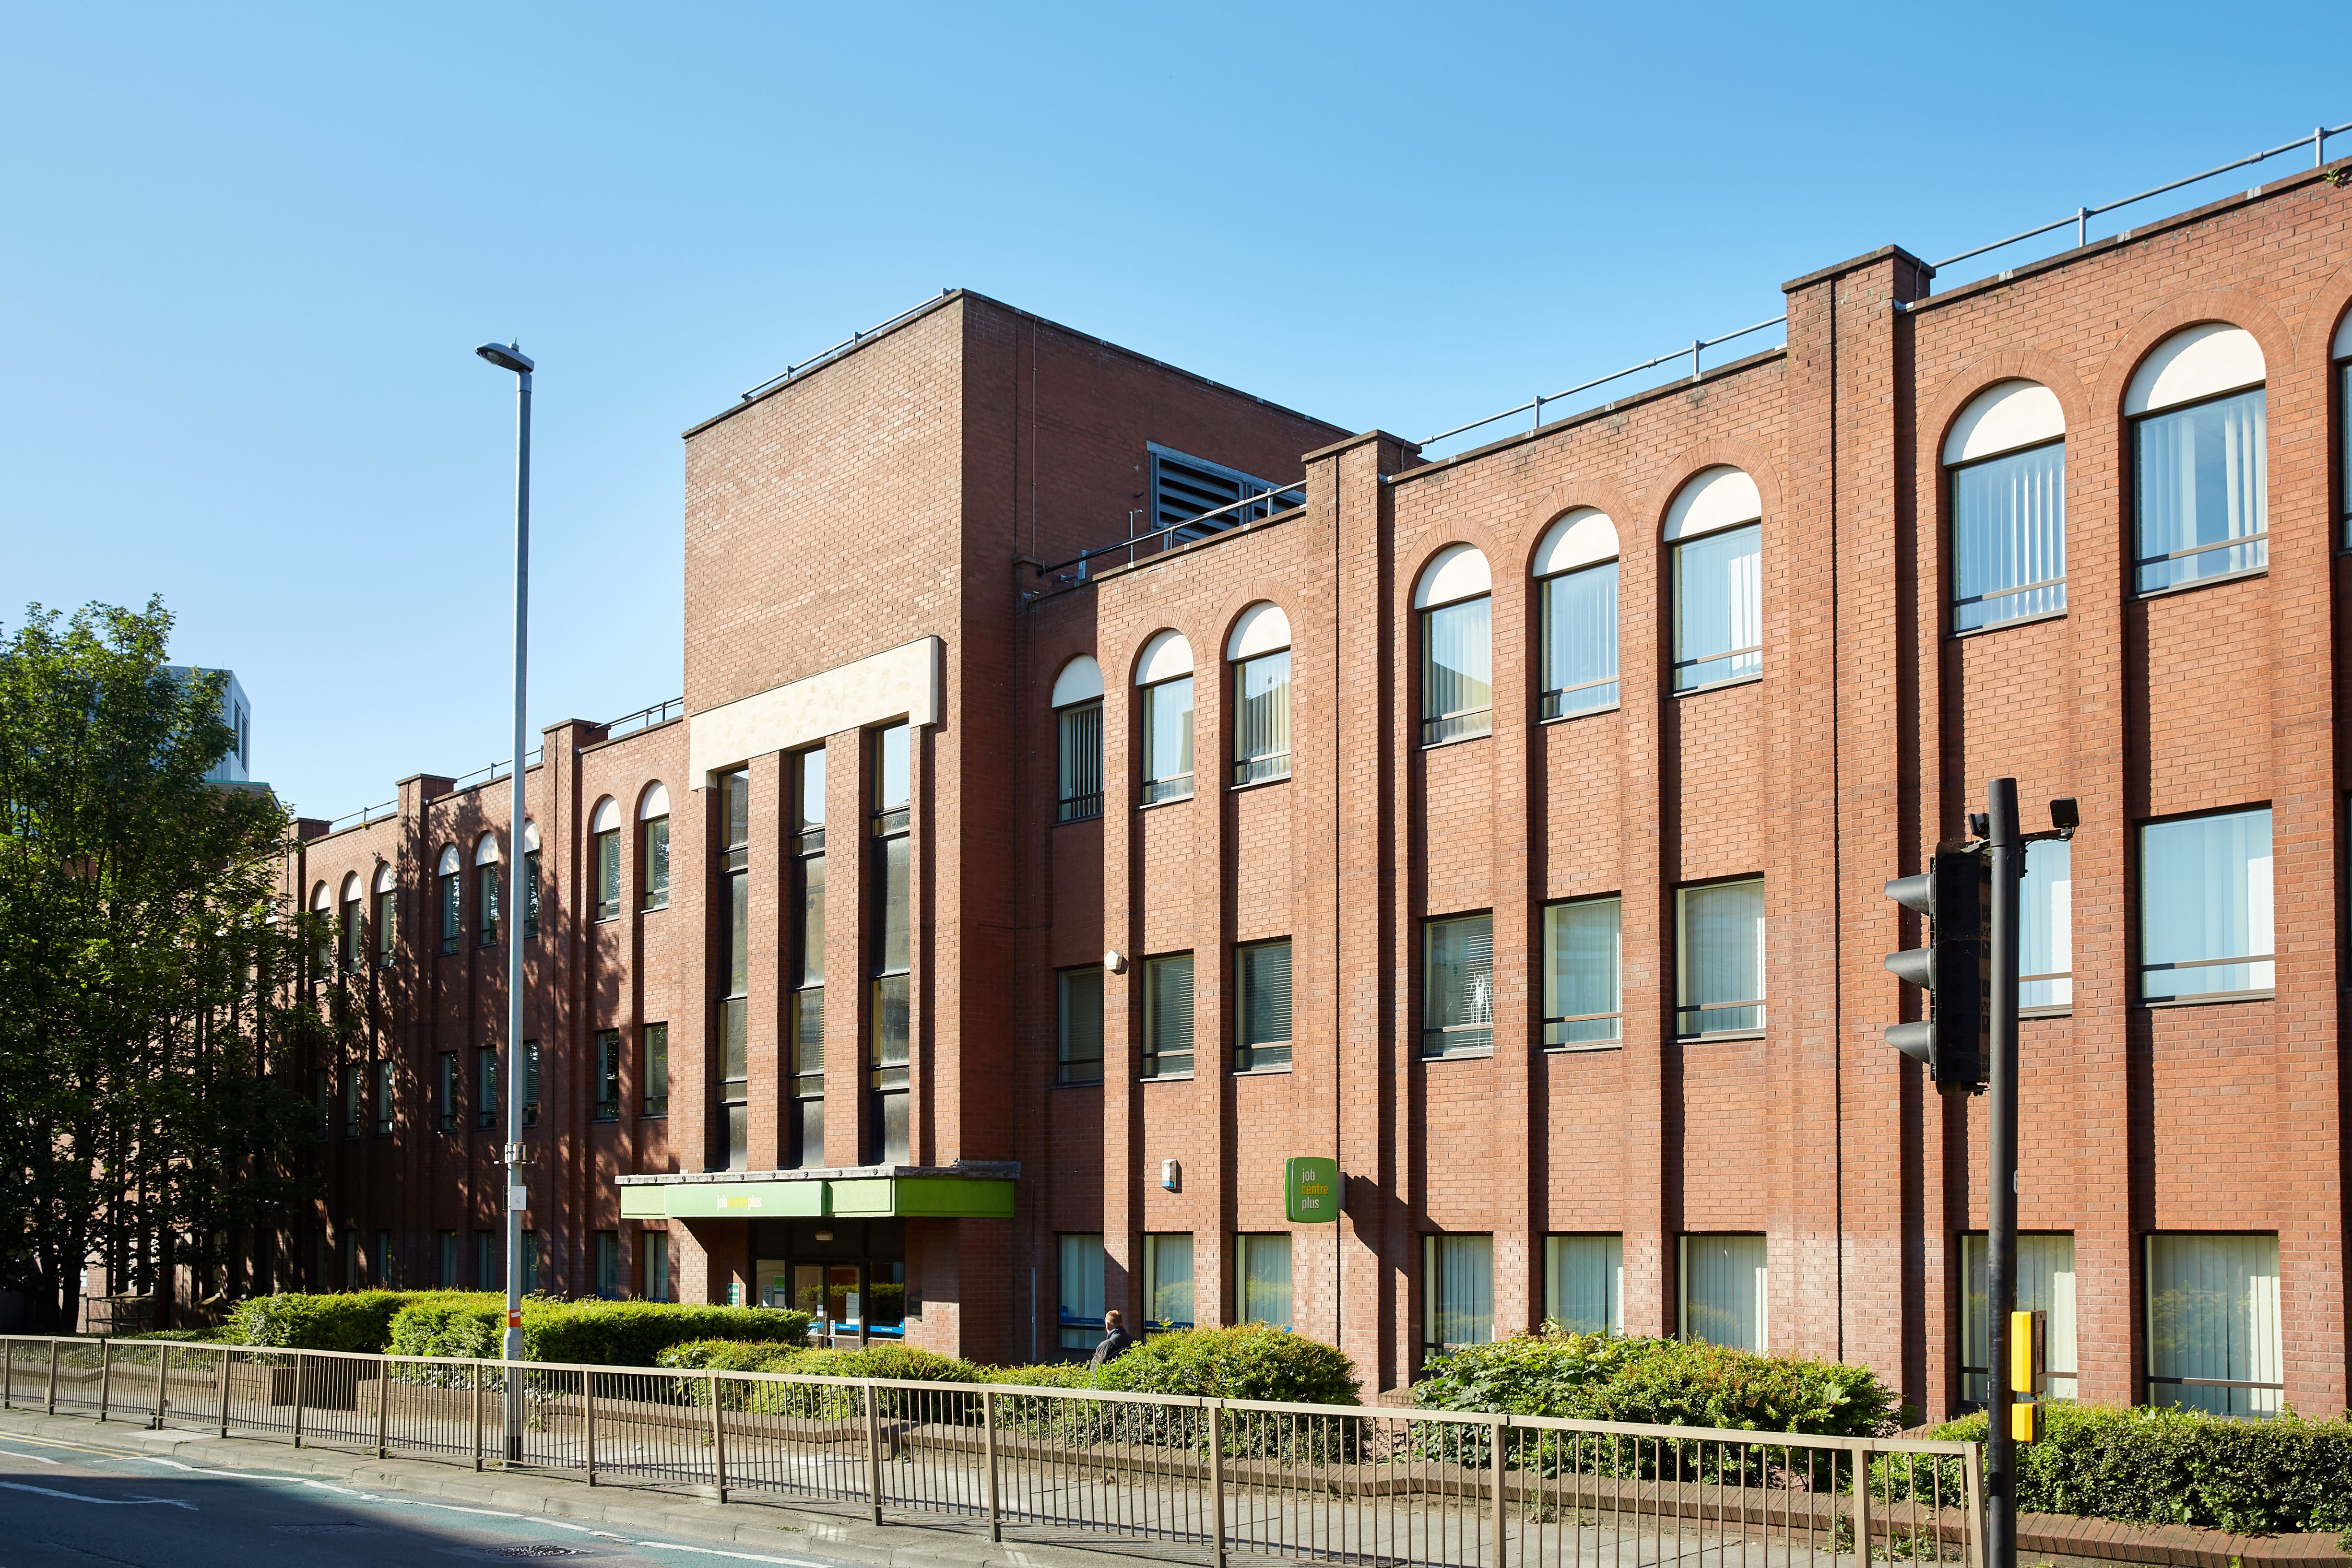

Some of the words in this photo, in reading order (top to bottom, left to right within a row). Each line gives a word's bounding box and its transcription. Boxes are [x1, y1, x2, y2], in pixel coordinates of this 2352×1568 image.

[1301, 1168, 1315, 1184] job
[1301, 1183, 1328, 1195] centre
[1301, 1196, 1320, 1212] plus
